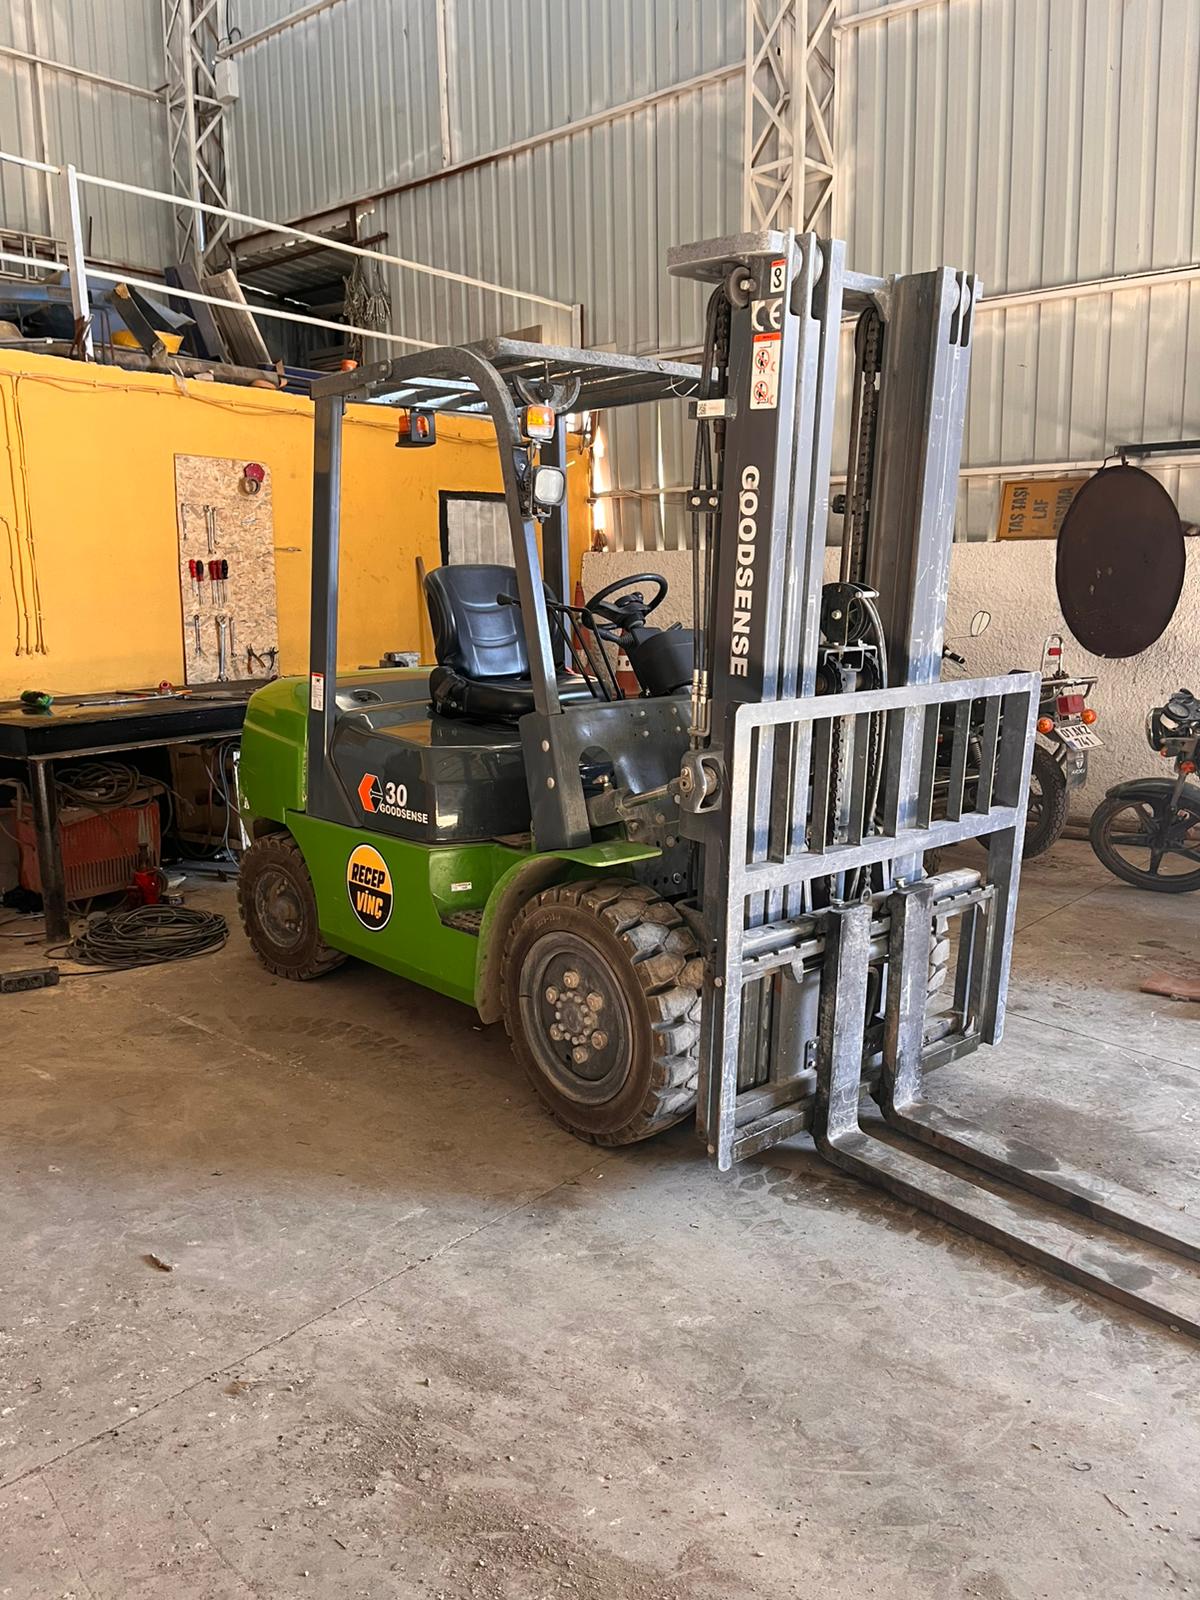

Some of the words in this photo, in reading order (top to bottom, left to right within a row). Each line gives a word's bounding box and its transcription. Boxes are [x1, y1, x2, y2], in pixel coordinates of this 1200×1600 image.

[752, 298, 783, 332] CE
[1032, 499, 1049, 519] LAF
[730, 465, 760, 677] GOODSENSE
[1060, 728, 1074, 738] 01
[1074, 736, 1095, 747] 741
[385, 782, 408, 807] 30
[379, 803, 429, 824] GOODSENSE
[352, 863, 386, 888] RECEP
[356, 890, 383, 919] VİNÇ
